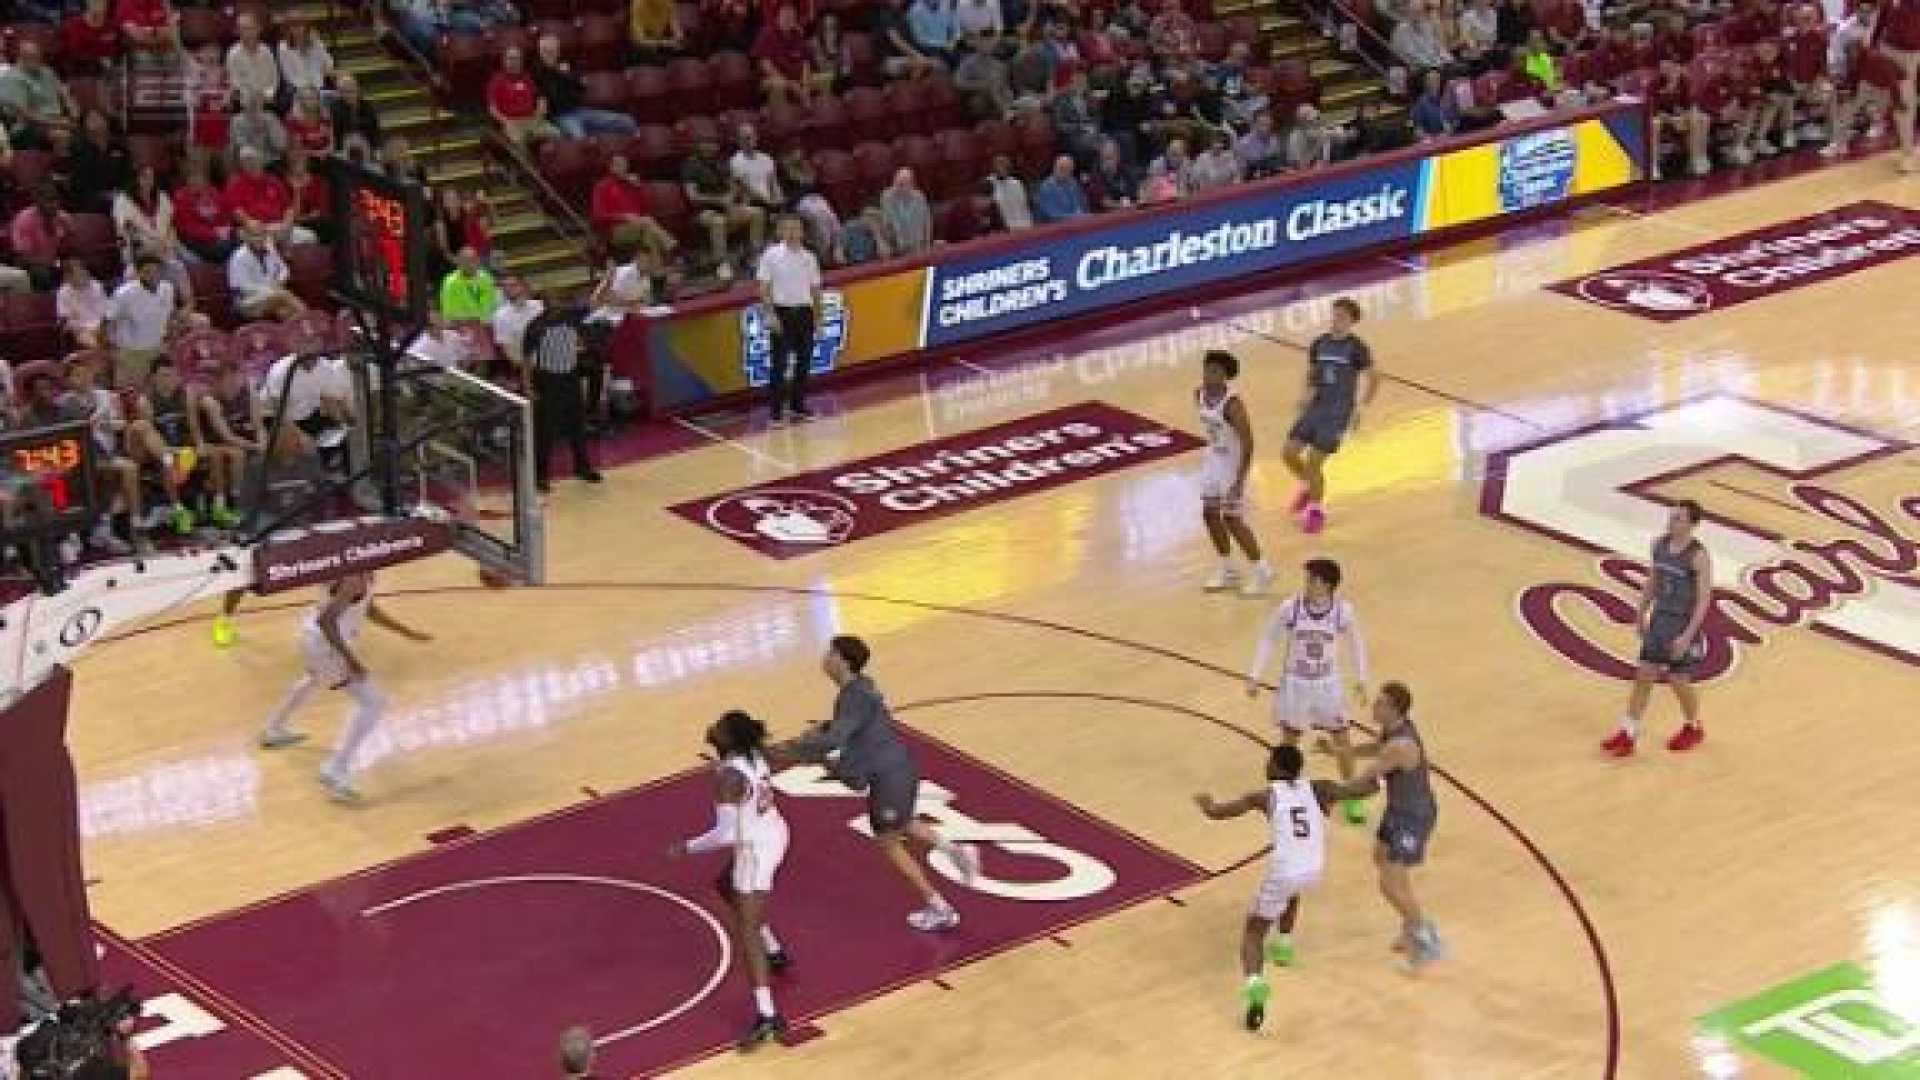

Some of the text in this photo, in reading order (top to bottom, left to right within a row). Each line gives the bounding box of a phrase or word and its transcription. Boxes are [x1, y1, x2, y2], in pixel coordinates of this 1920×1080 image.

[1077, 183, 1408, 290] Charleston Classic
[942, 256, 1050, 301] SHRINERS
[939, 279, 1068, 327] CHILDREN'S
[832, 422, 1101, 493] Shriners
[879, 433, 1174, 511] Children's
[268, 556, 341, 581] Shriners
[1289, 806, 1311, 841] 5
